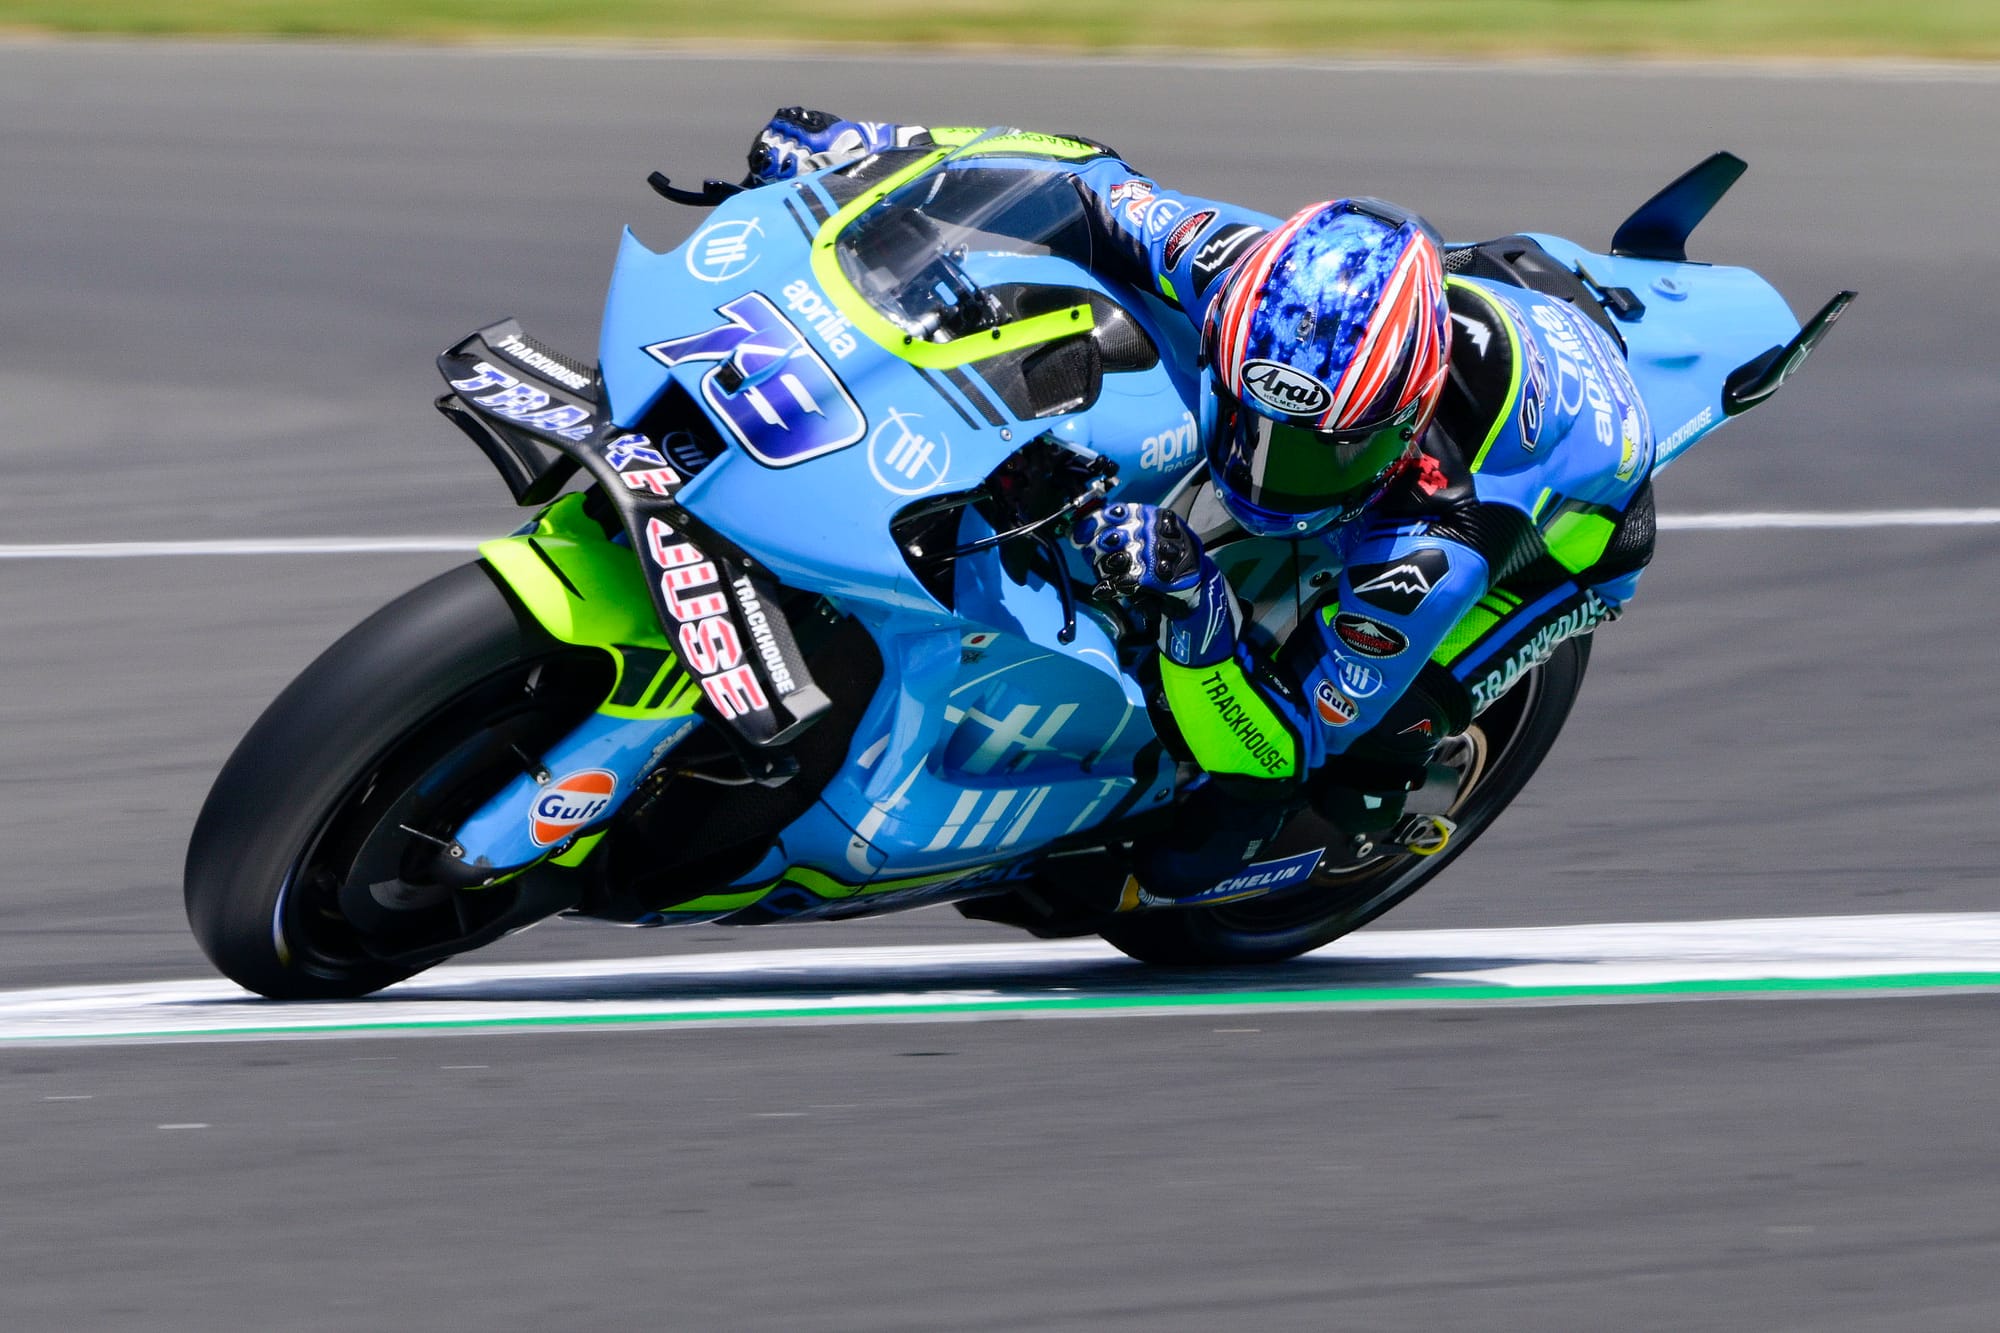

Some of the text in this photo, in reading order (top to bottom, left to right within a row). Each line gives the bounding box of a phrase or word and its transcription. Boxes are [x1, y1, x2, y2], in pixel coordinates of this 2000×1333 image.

[782, 279, 857, 360] aprilia
[498, 334, 591, 390] TRACKHOUSE
[1246, 368, 1321, 405] Arai
[1656, 406, 1712, 462] TRACKHOUSE
[733, 575, 796, 694] TRACKHOUSE
[1202, 670, 1289, 774] TRACKHOUSE
[1319, 684, 1356, 720] Gulf
[538, 794, 608, 819] Gulf
[1199, 864, 1302, 896] CHELIN
